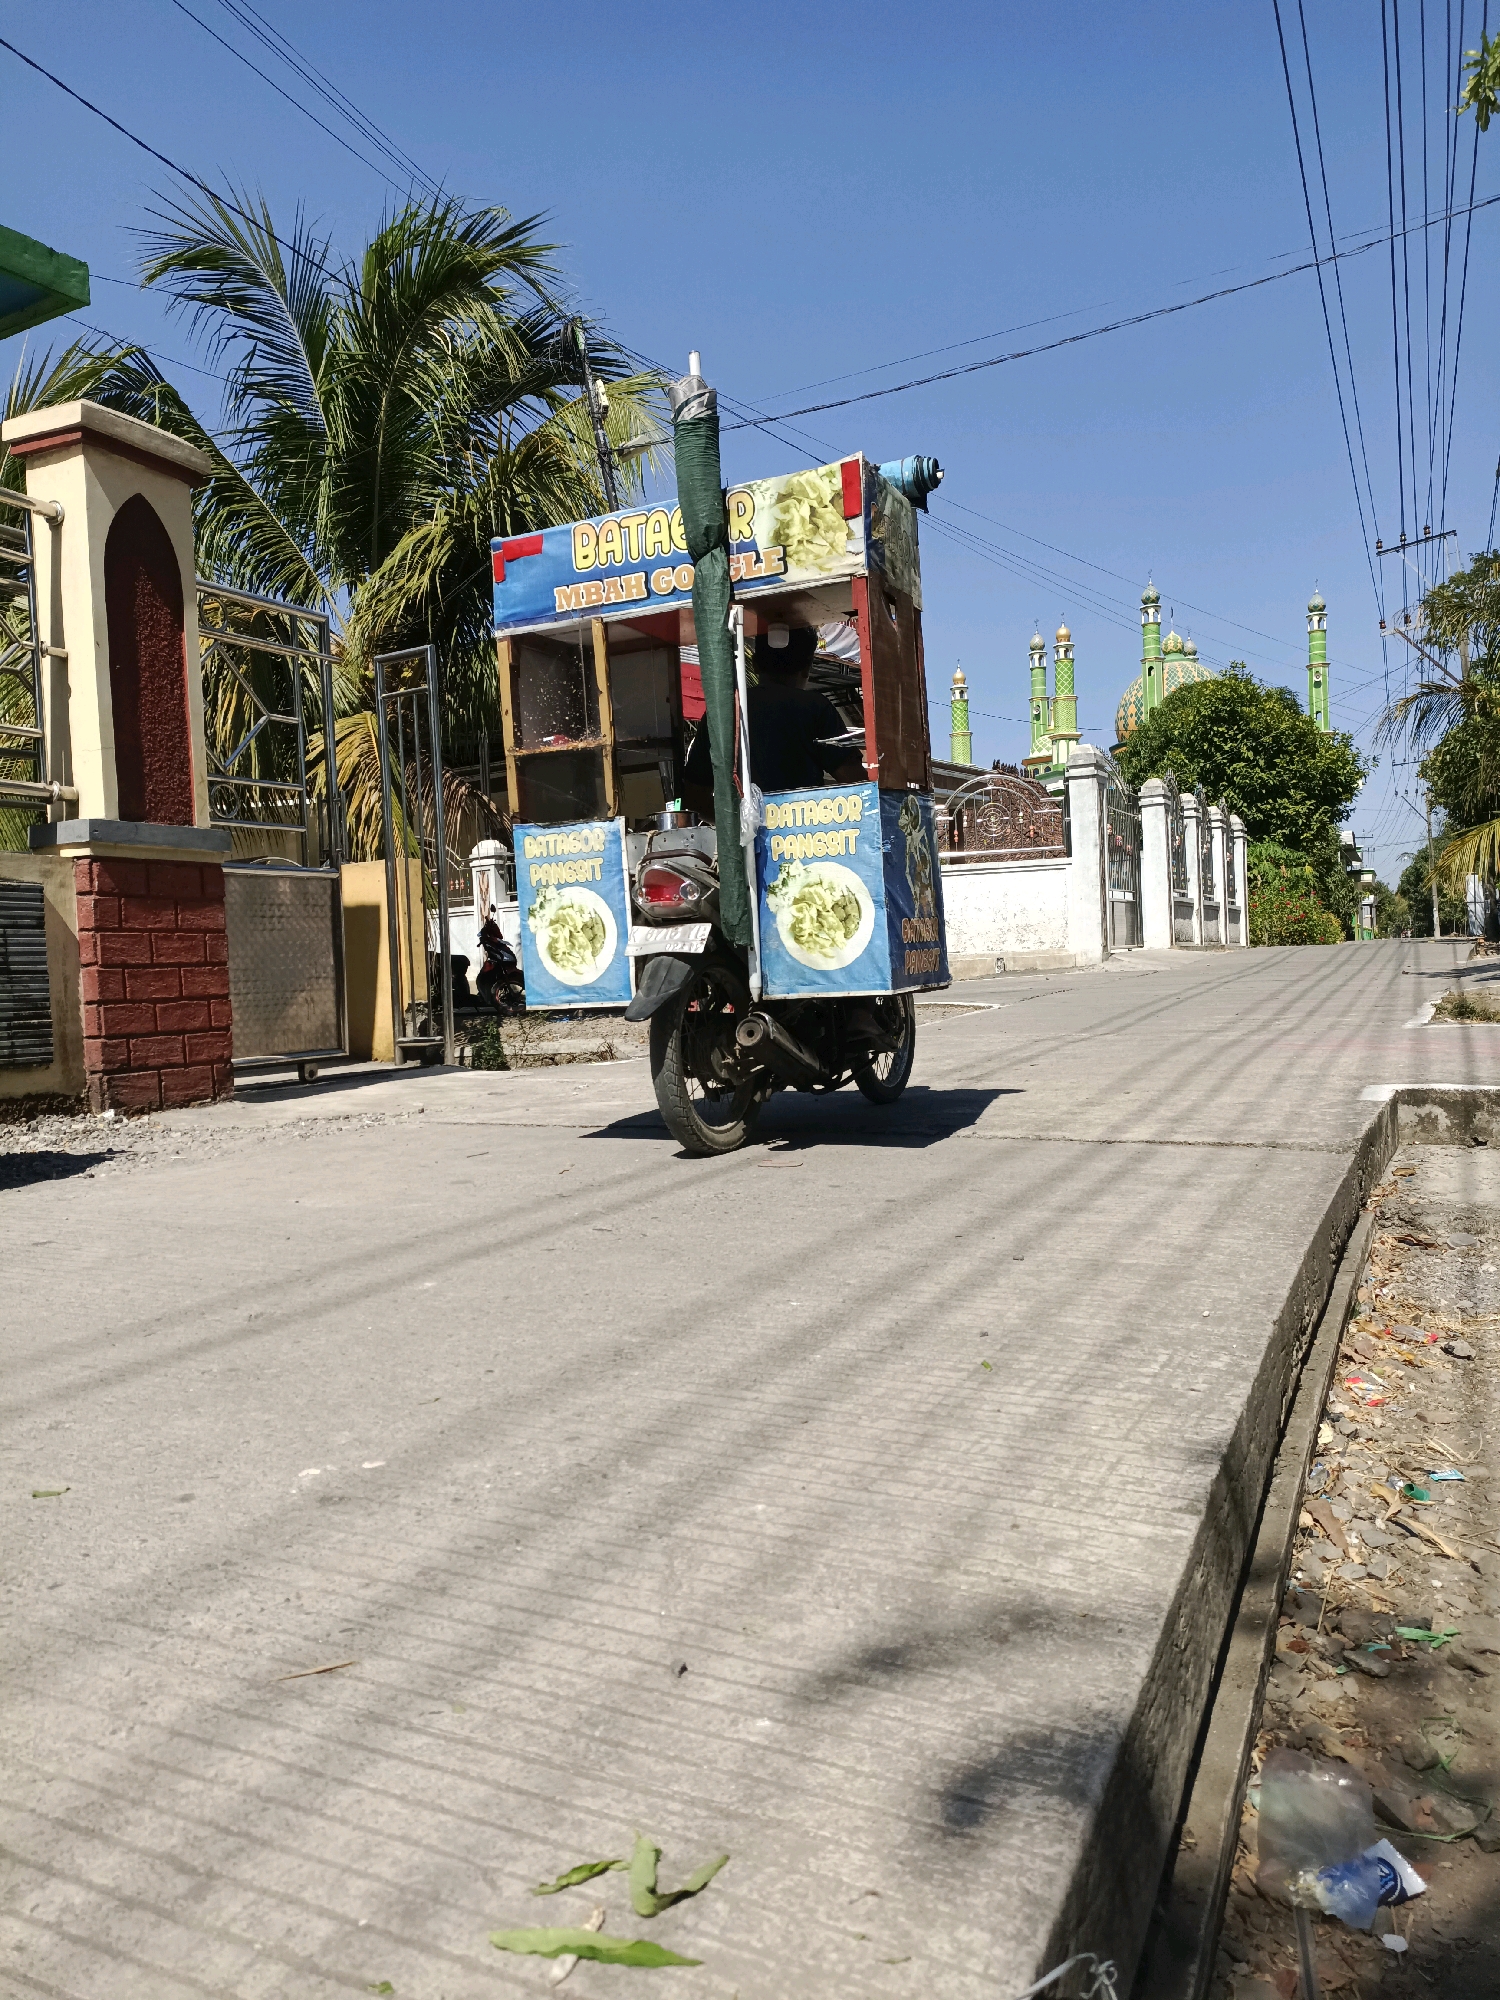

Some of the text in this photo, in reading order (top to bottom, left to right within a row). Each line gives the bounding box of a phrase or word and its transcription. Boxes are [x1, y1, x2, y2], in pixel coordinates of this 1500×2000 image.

[571, 489, 756, 572] BATAGR
[554, 545, 787, 612] MBAH GOGLE
[765, 794, 862, 830] BATAGOR
[523, 827, 606, 860] BATAGOR
[770, 828, 860, 861] PANGSIT
[529, 857, 604, 887] PANGSIT
